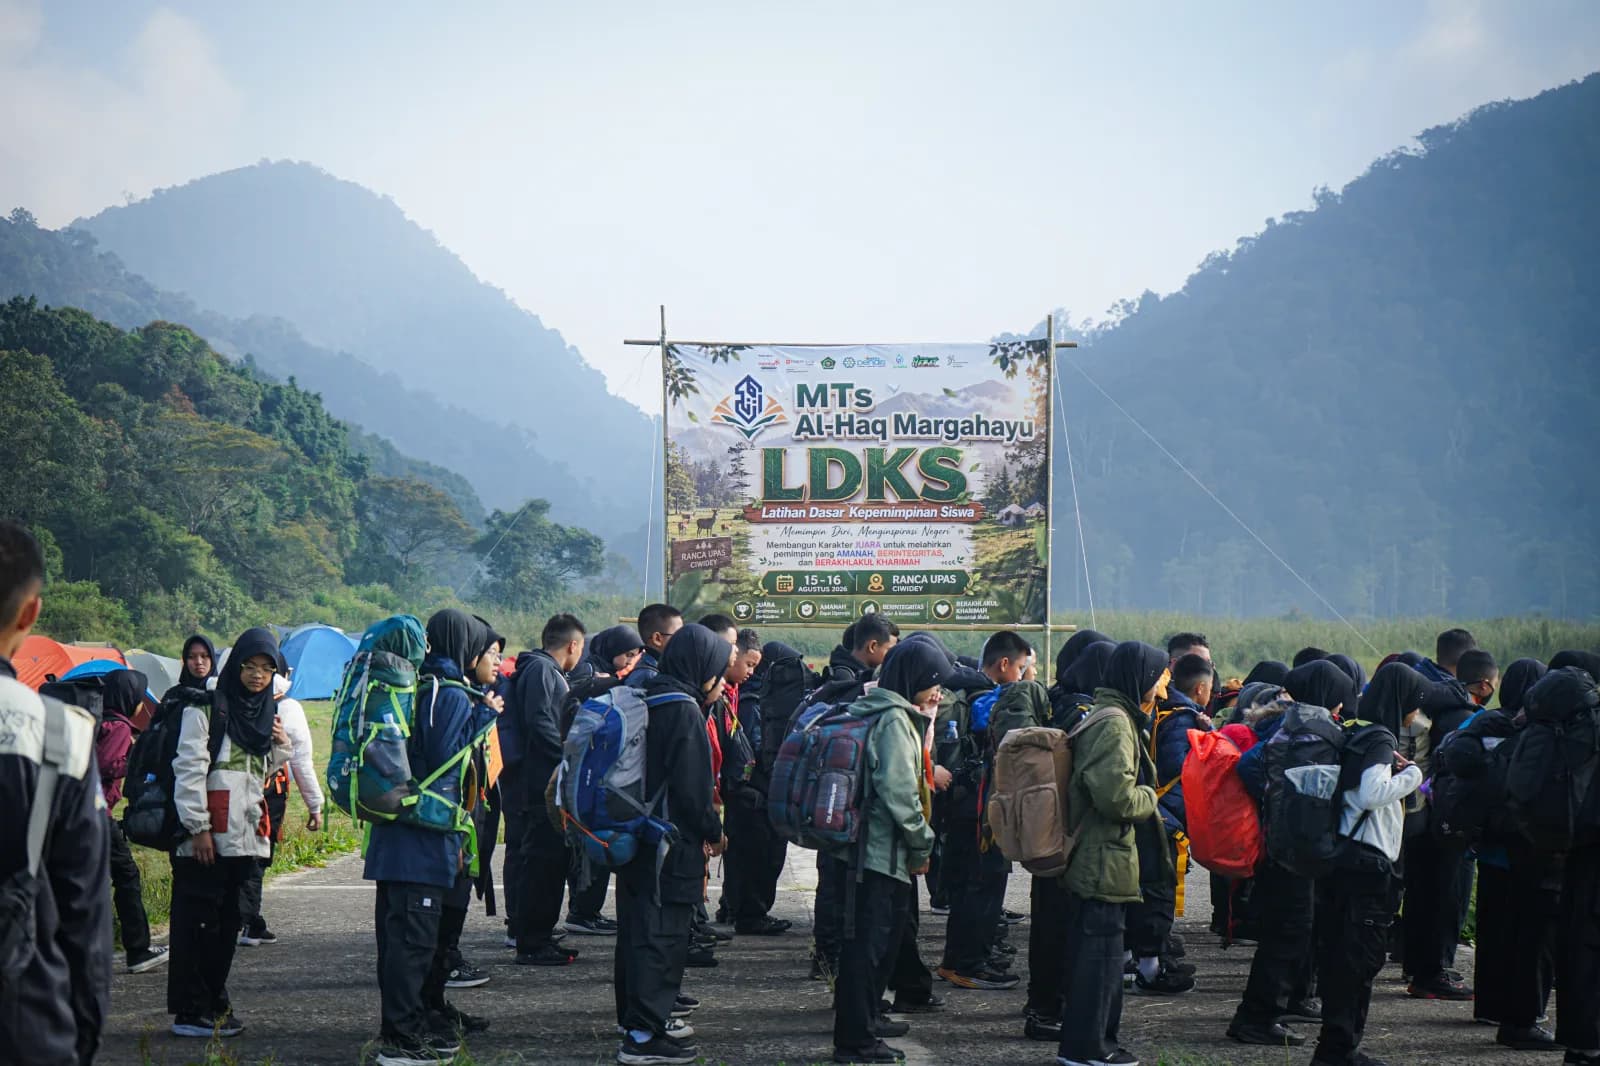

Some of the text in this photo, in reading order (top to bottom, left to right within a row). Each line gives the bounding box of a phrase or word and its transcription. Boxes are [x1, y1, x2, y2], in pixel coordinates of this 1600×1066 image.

[796, 383, 873, 408] MTs
[794, 413, 1033, 441] Al-Haq Margahayu
[761, 446, 968, 503] LDKS
[761, 505, 975, 520] Latihan Dasar Kepemimpinan Siswa
[858, 525, 917, 539] Menginspirasi
[766, 541, 952, 550] Membangun Karakter JUARA untuk melahirkan
[681, 550, 726, 561] RANCA UPAS
[836, 550, 876, 558] AMANAH,
[877, 549, 945, 558] BERINTEGRITAS,
[690, 559, 718, 569] CIWIDEY
[876, 558, 921, 566] KHARIMAH
[892, 574, 957, 584] RANCA UPAS
